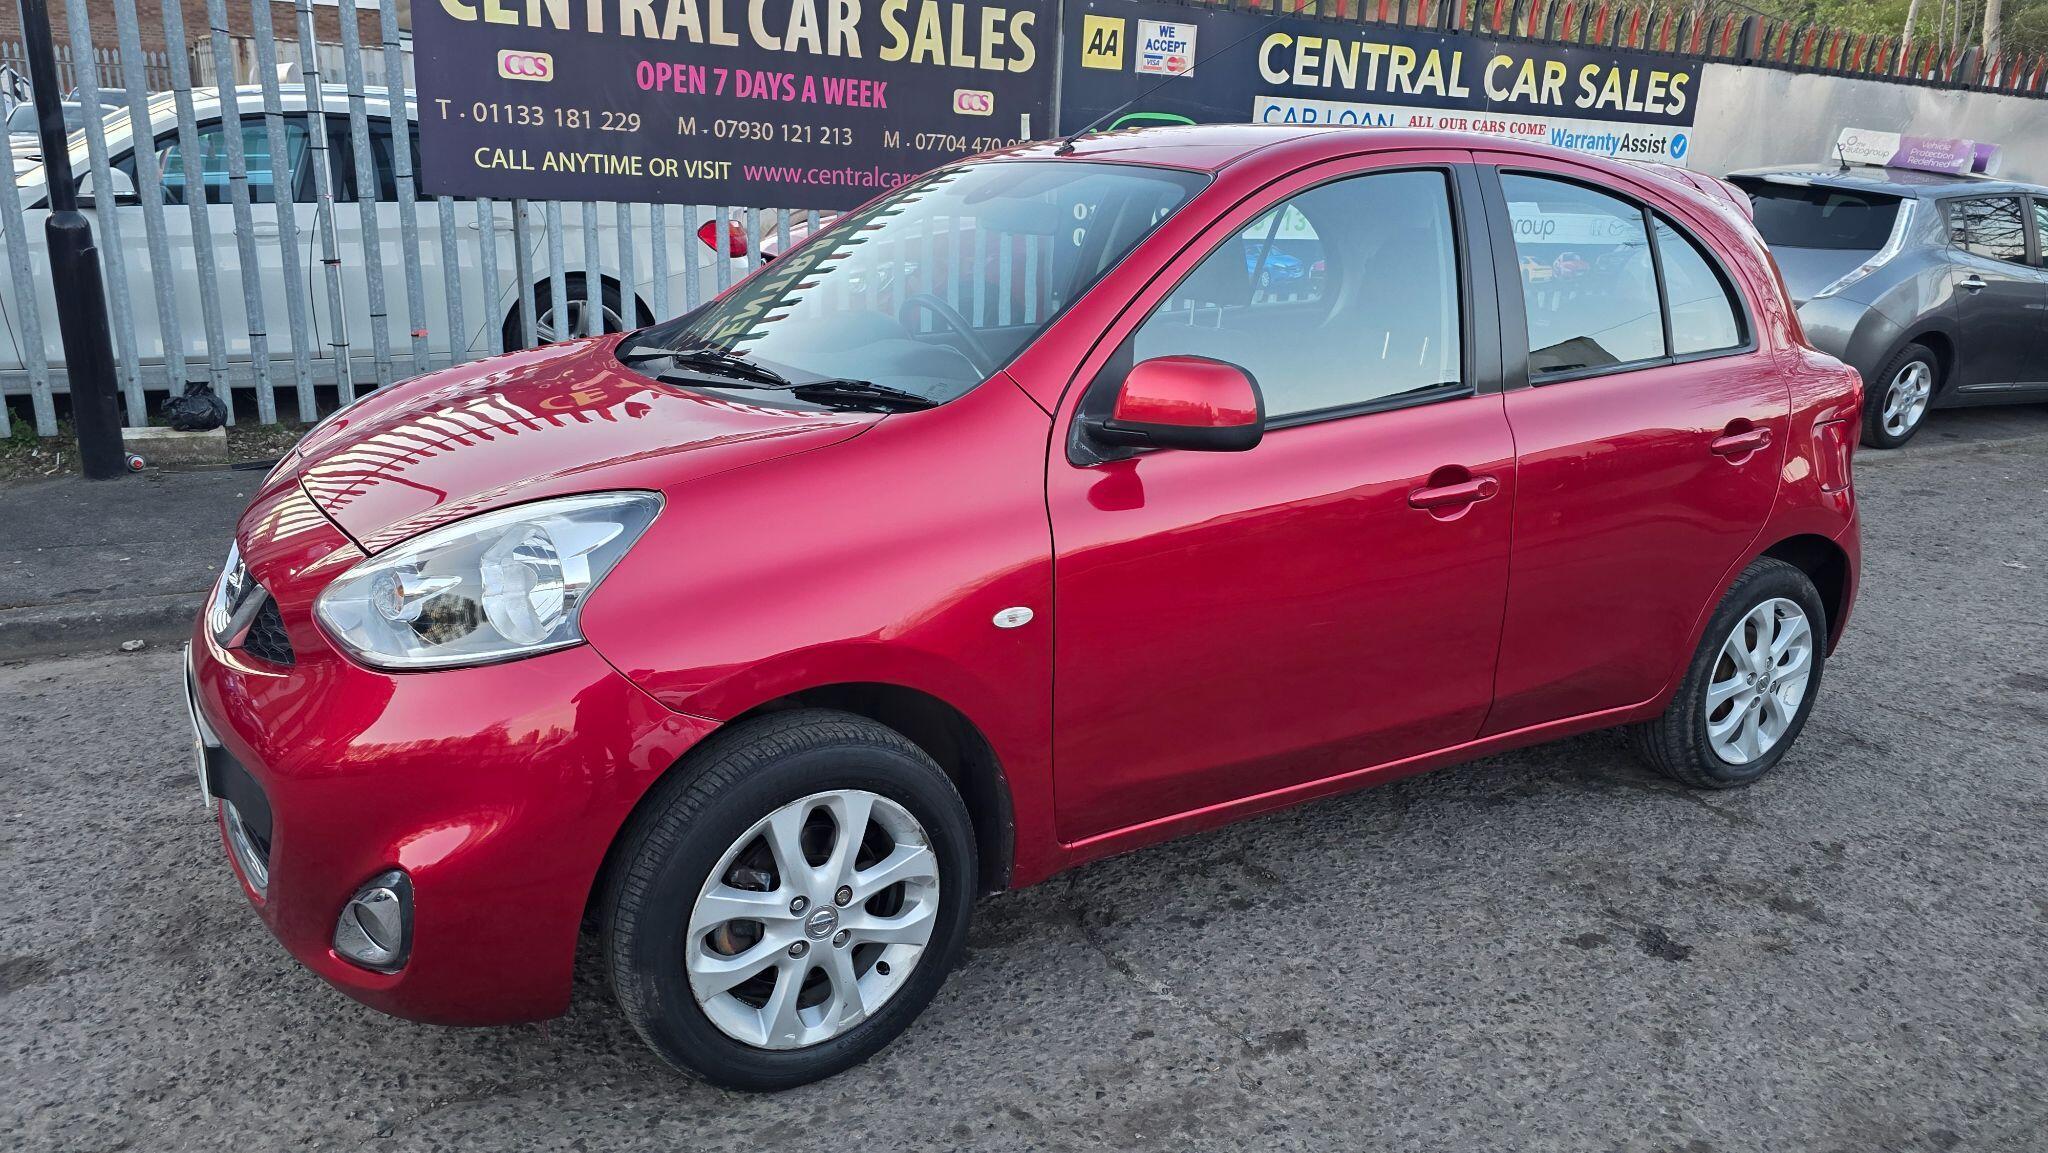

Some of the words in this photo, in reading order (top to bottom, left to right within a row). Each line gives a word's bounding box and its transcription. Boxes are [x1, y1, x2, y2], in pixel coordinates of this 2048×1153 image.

[748, 0, 862, 58] CAR
[879, 0, 1036, 73] SALES
[1087, 28, 1118, 57] AA
[1159, 25, 1176, 38] WE
[1145, 39, 1187, 53] ACCEPT
[504, 54, 548, 77] CCS
[1258, 32, 1470, 98] CENTRAL
[1483, 54, 1567, 106] CAR
[1575, 63, 1690, 116] SALES
[636, 60, 706, 94] OPEN
[713, 68, 728, 96] 7
[735, 69, 796, 102] DAYS
[801, 75, 817, 103] A
[823, 76, 887, 109] WEEK
[957, 93, 989, 112] CCS
[472, 102, 544, 126] 01133
[554, 108, 591, 129] 181
[600, 111, 641, 132] 229
[1408, 115, 1433, 128] ALL
[1439, 117, 1468, 130] OUR
[1472, 119, 1506, 133] CARS
[1509, 122, 1547, 136] COME
[714, 119, 774, 141] 07930
[781, 124, 811, 143] 121
[819, 126, 853, 146] 213
[915, 133, 967, 152] 07704
[971, 137, 1001, 153] 470
[1910, 148, 1953, 160] Protection
[1922, 141, 1952, 151] Vehicle
[474, 147, 535, 170] CALL
[542, 151, 643, 176] ANYTIME
[649, 157, 678, 178] OR
[684, 159, 732, 180] VISIT
[1907, 156, 1951, 168] Redefined
